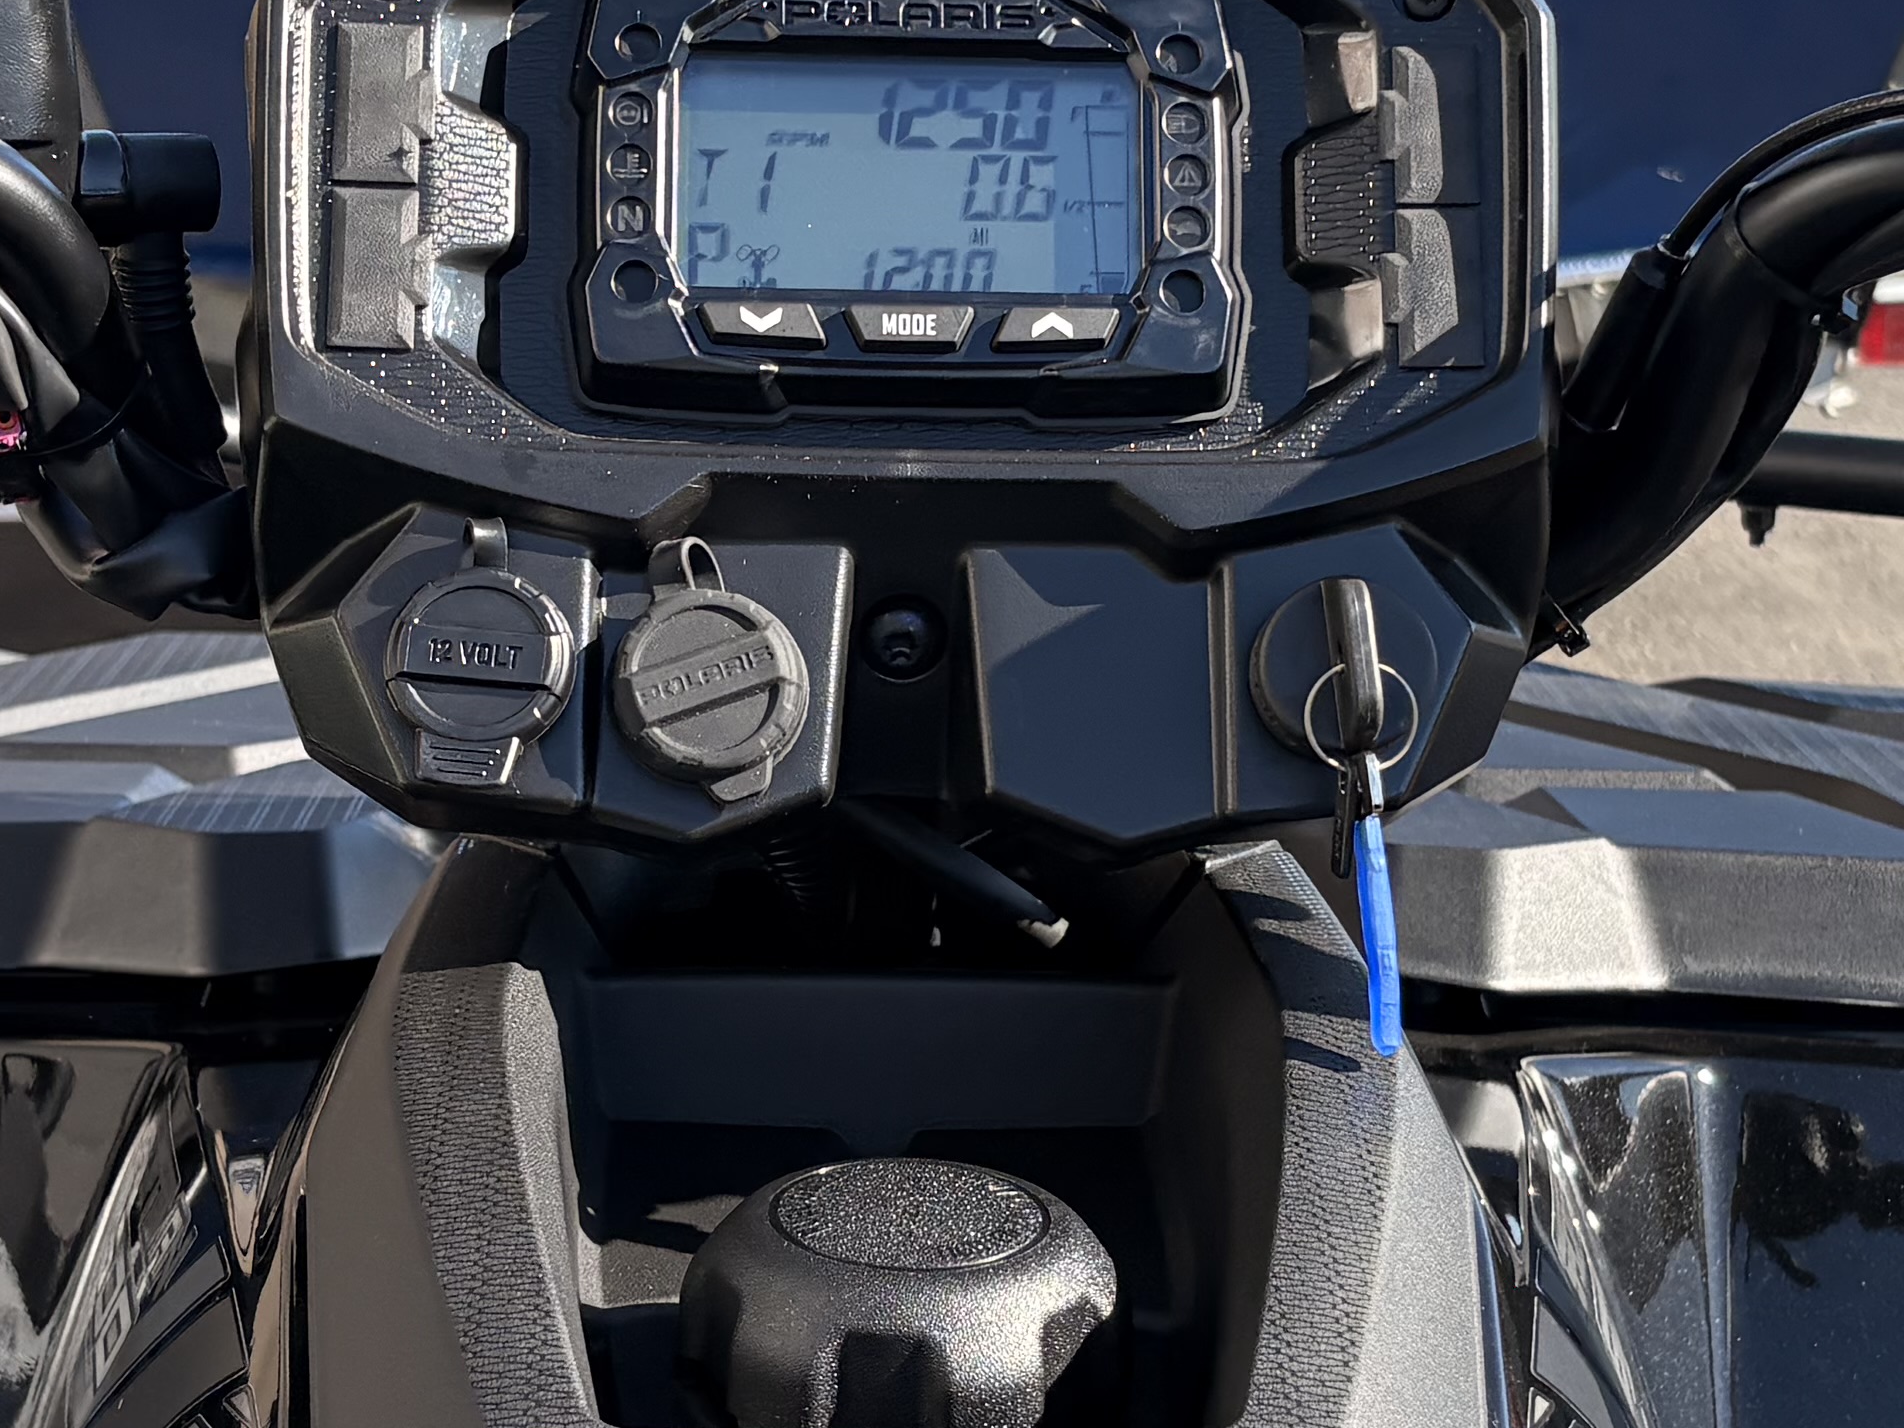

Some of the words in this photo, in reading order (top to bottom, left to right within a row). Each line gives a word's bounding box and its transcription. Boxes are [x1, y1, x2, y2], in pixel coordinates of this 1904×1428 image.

[781, 0, 1040, 32] POLARIS
[878, 79, 1056, 151] 1250
[881, 312, 938, 337] MODE
[459, 639, 524, 670] VOLT
[635, 645, 774, 708] POLARIS
